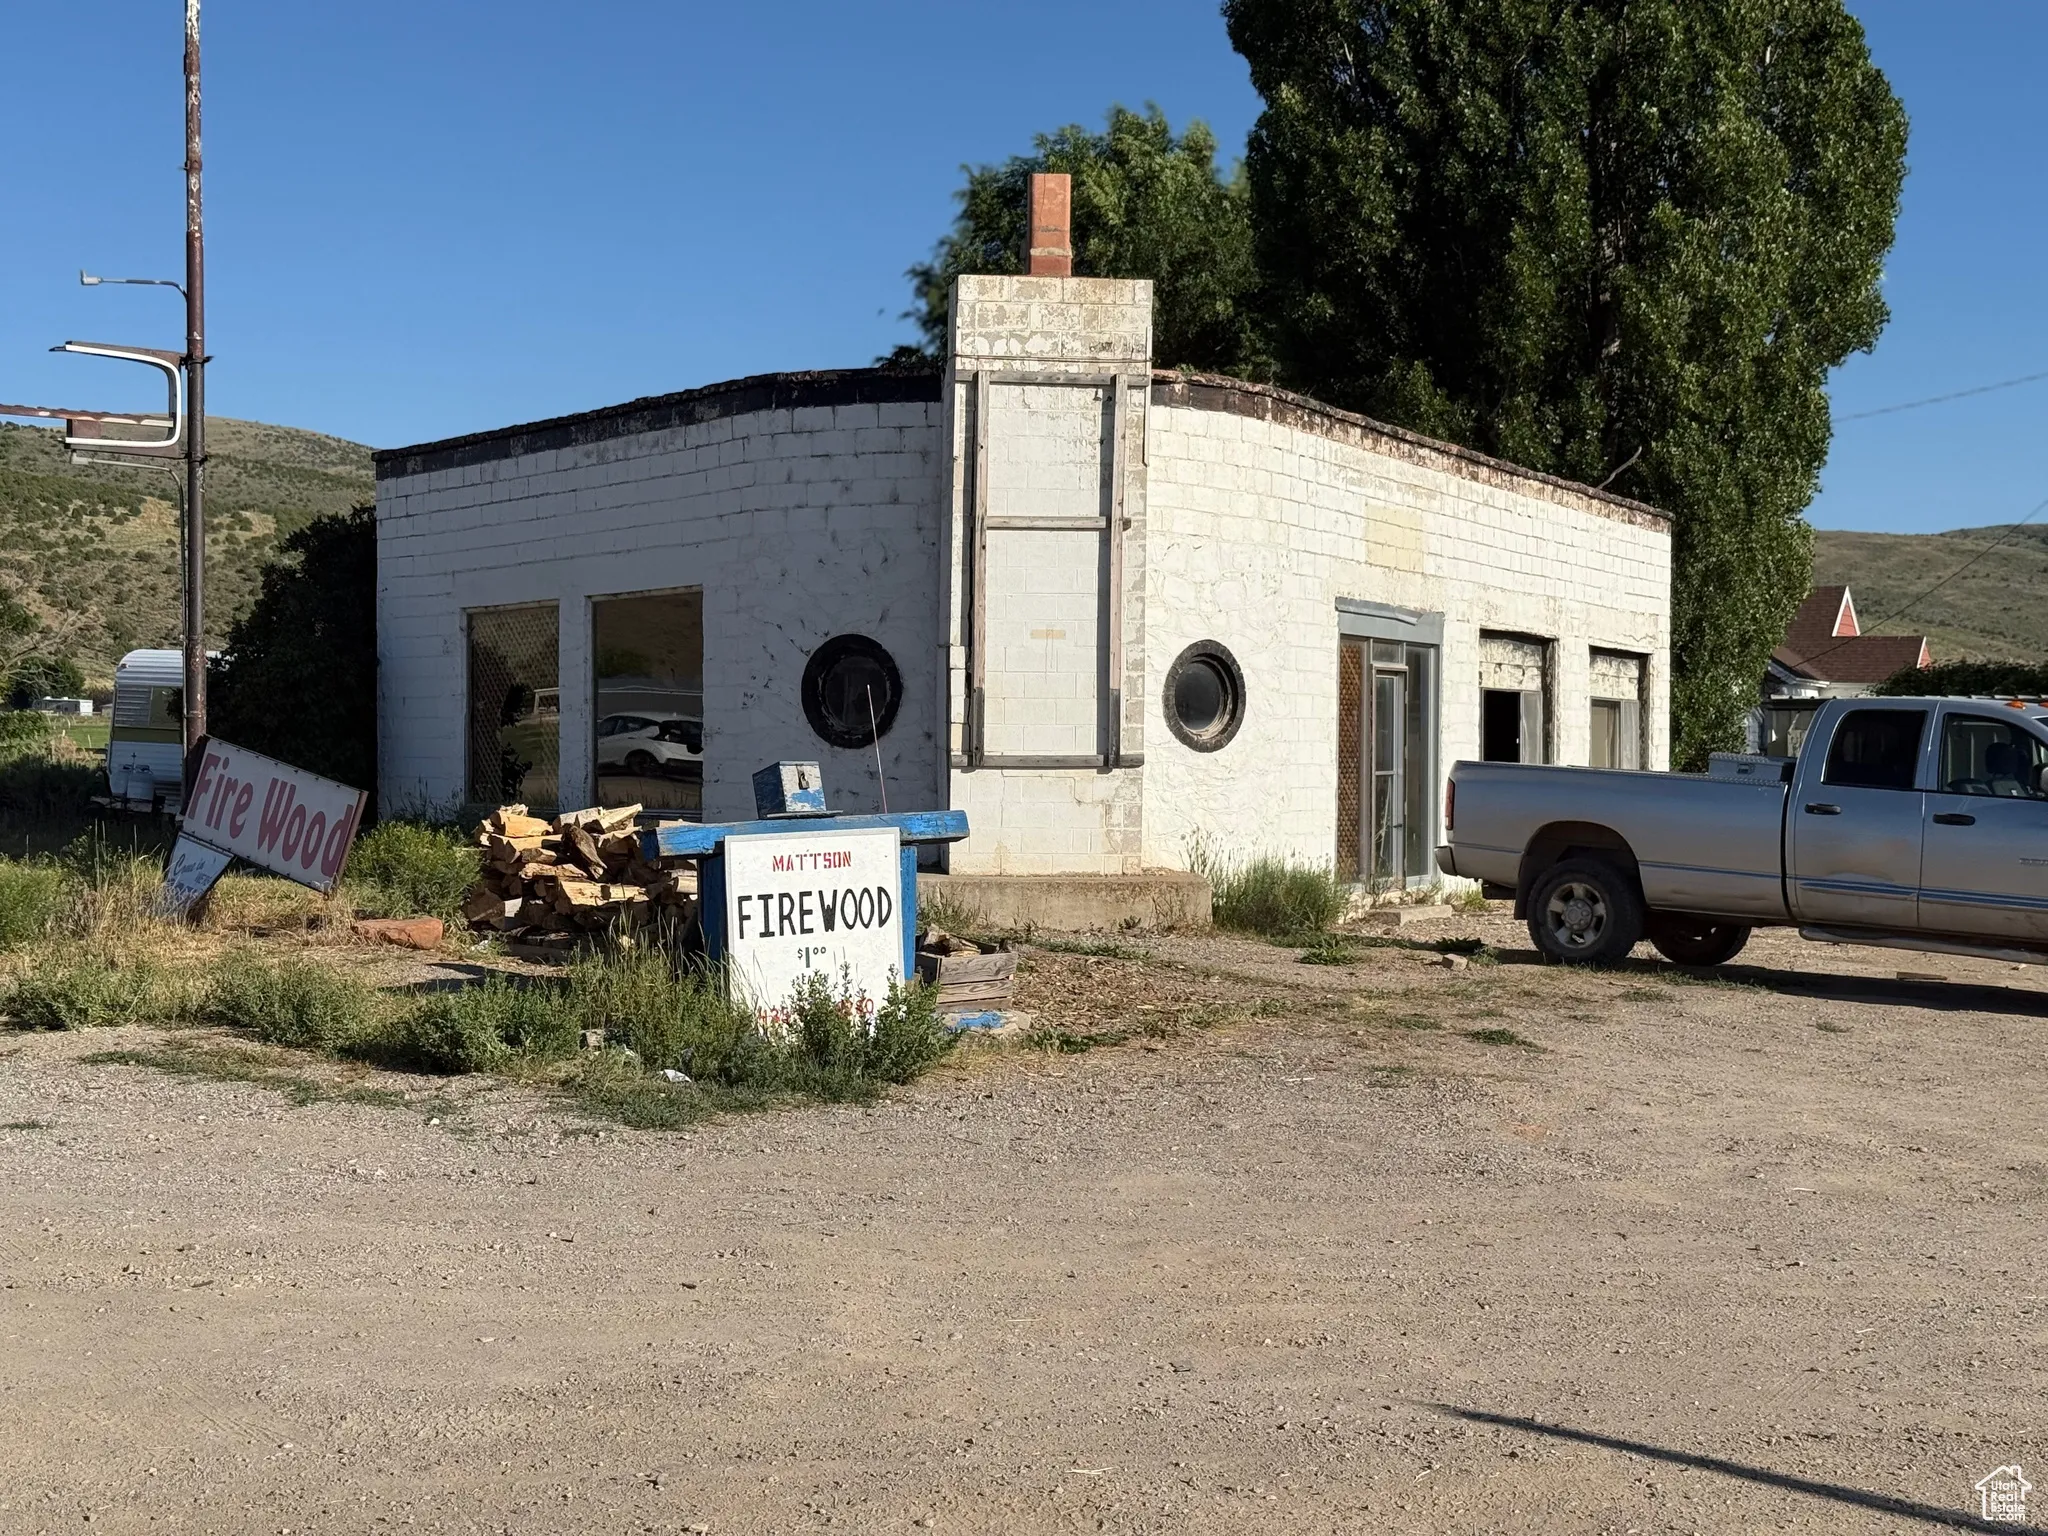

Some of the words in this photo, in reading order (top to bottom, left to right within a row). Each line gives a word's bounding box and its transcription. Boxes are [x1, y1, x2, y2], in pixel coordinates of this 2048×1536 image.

[187, 752, 254, 840] Fire
[257, 777, 355, 878] Wood
[772, 850, 852, 872] MATTSON
[737, 886, 893, 940] FIREWOOD
